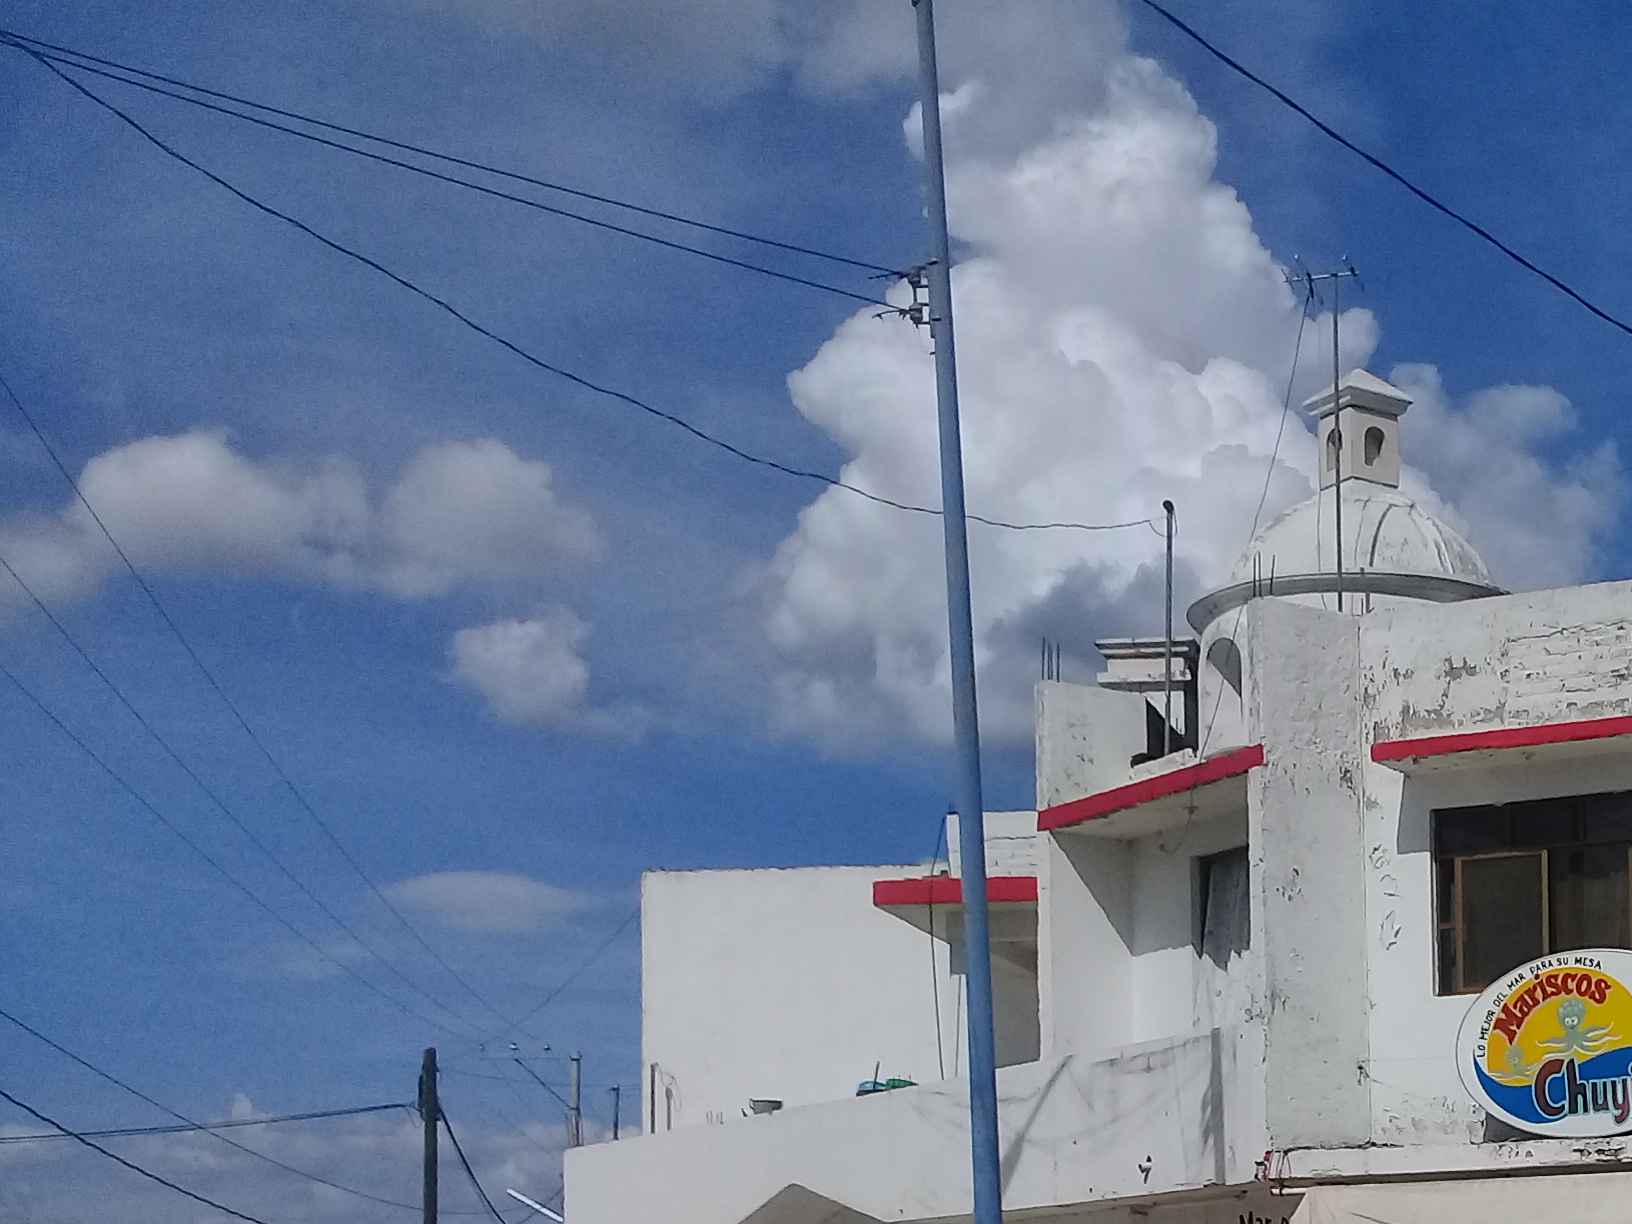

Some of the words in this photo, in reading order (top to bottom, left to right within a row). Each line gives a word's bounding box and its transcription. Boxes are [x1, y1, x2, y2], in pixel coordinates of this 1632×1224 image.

[1529, 961, 1555, 976] PARA
[1556, 957, 1569, 967] SU
[1574, 956, 1603, 971] MESA
[1506, 973, 1527, 992] MAR
[1493, 992, 1508, 1008] DEL
[1492, 972, 1613, 1047] Mariscos
[1479, 1009, 1497, 1041] MEJOR
[1476, 1044, 1486, 1059] LO
